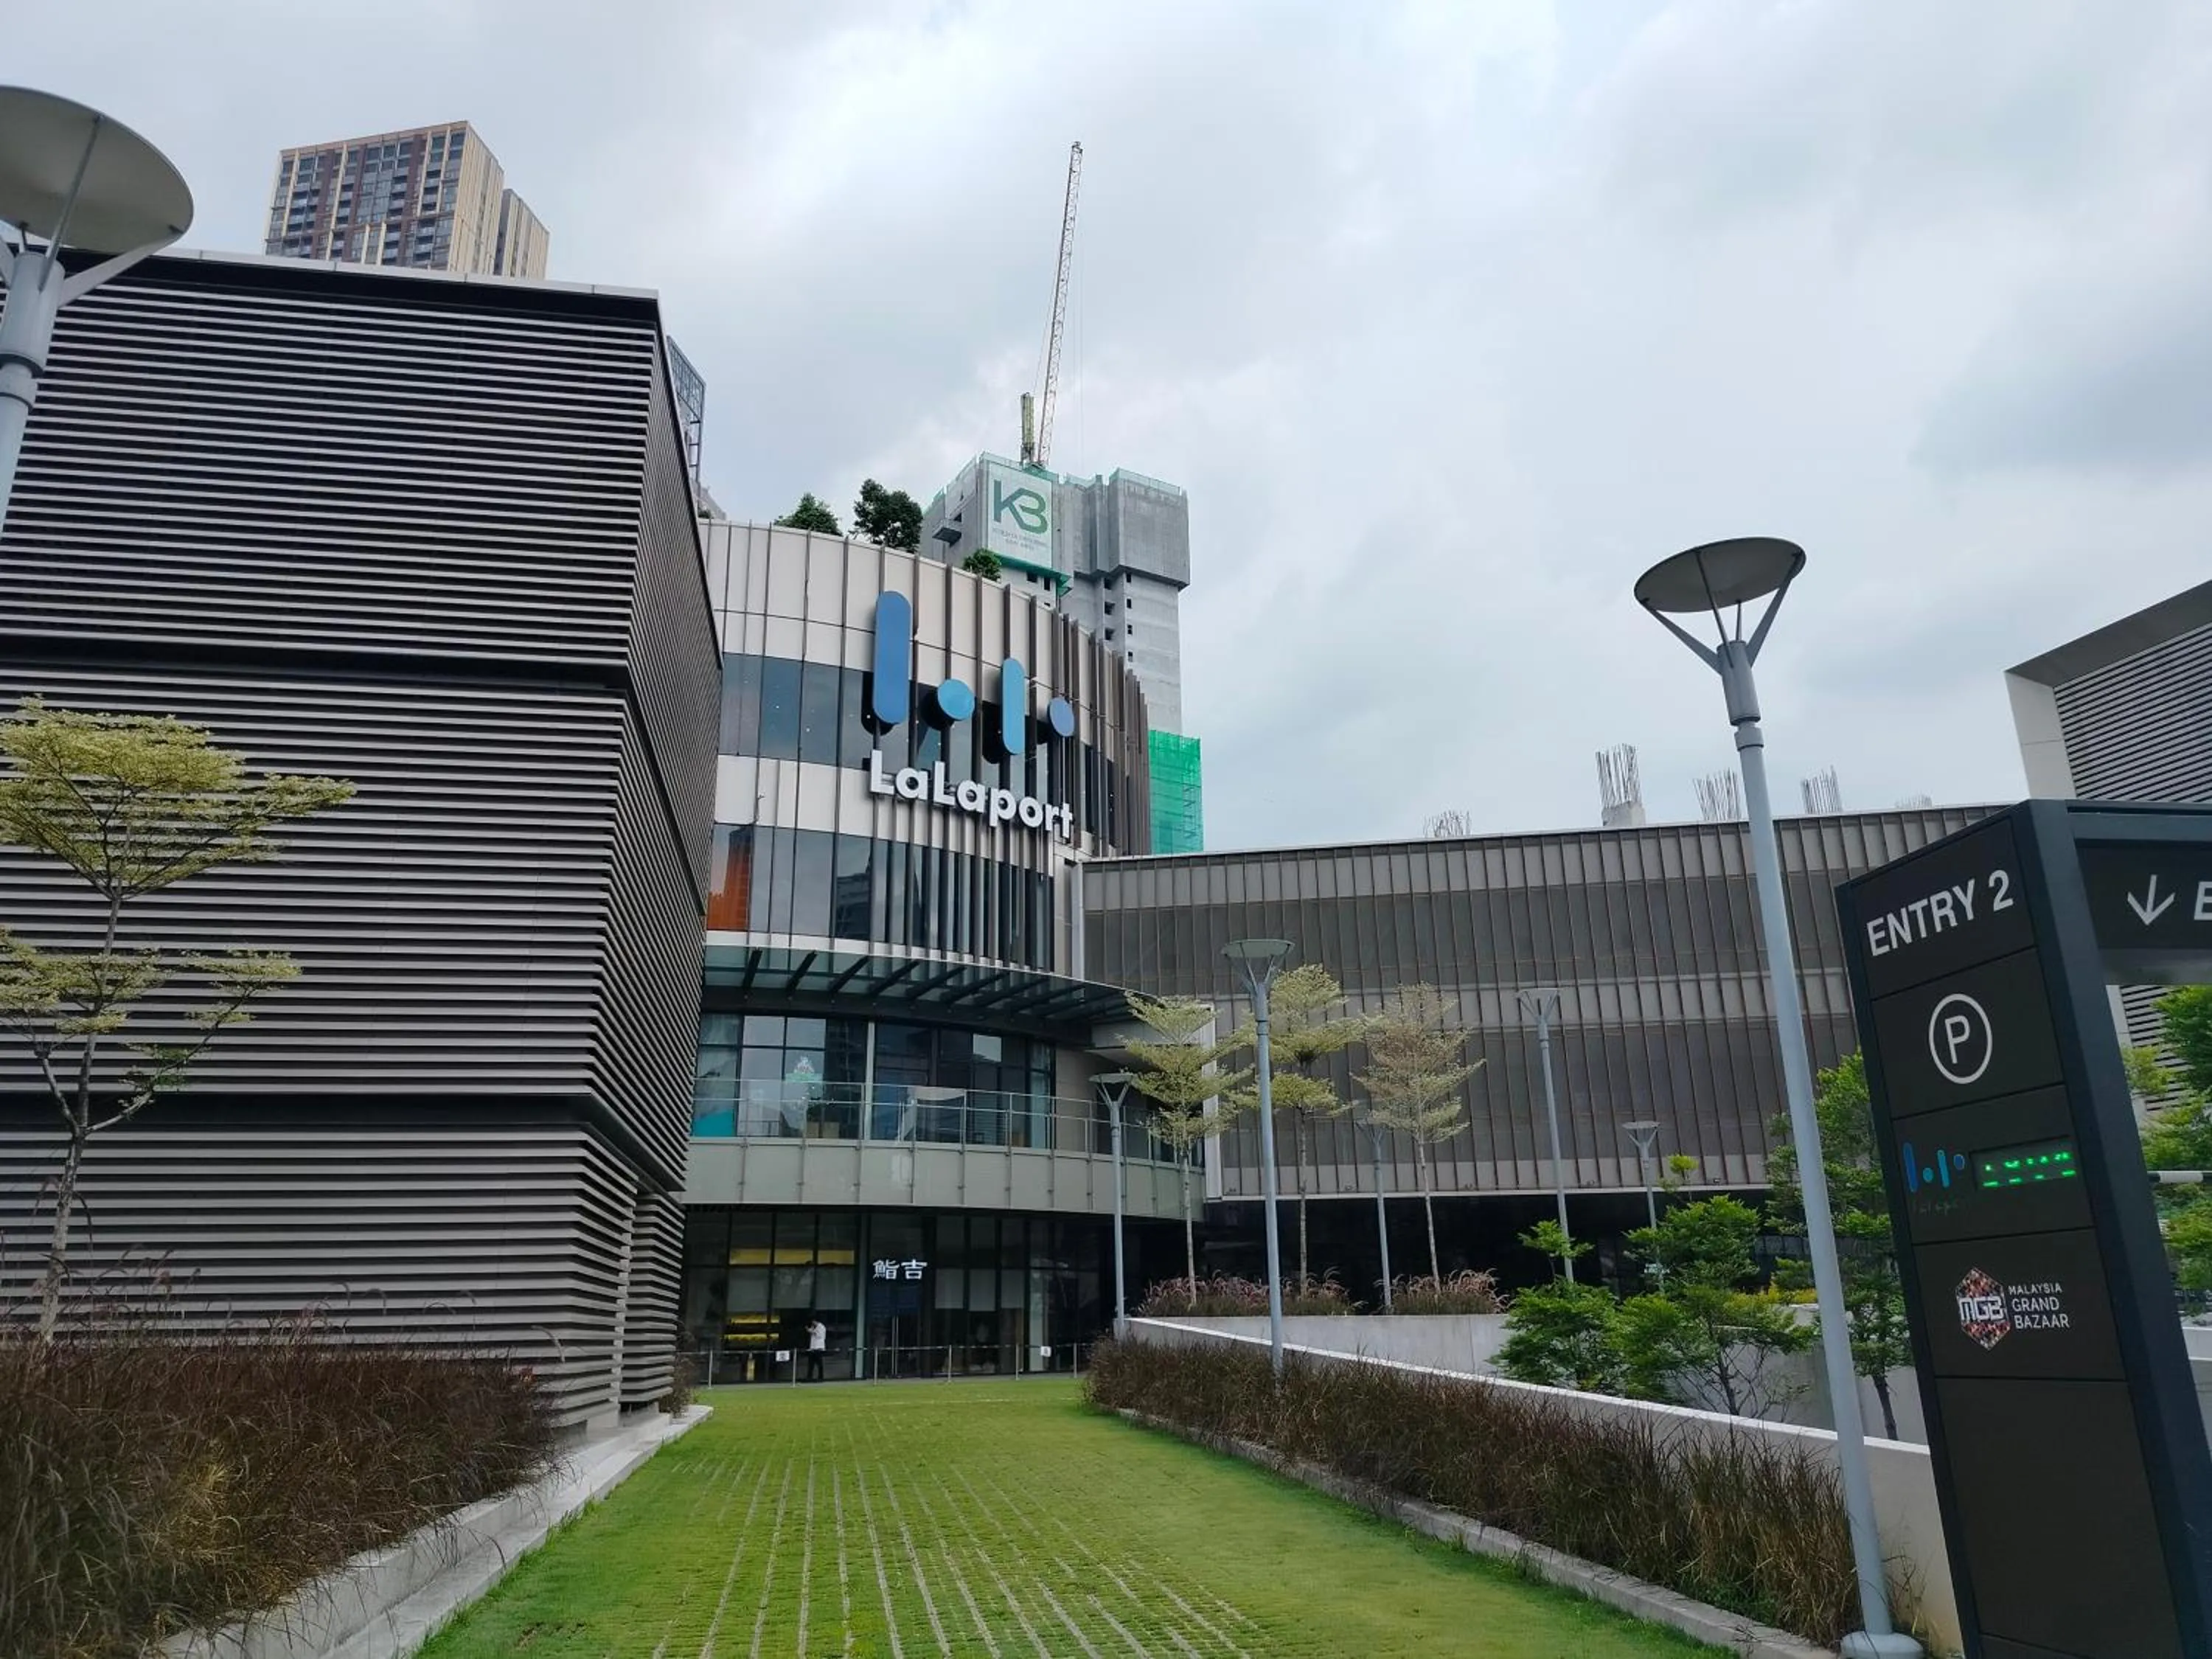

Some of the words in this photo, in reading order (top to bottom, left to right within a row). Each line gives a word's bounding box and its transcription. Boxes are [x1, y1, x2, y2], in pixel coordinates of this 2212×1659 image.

[993, 479, 1048, 535] KB
[870, 748, 1074, 840] LaLaport
[1866, 878, 1976, 957] ENTRY
[1988, 869, 2014, 912] 2
[1944, 1015, 1971, 1065] P
[872, 1259, 928, 1280] 鮨吉
[2008, 1282, 2063, 1295] MALAYSIA
[1959, 1295, 2005, 1321] MGB
[2011, 1296, 2060, 1312] GRAND
[2014, 1312, 2071, 1330] BAZAAR
